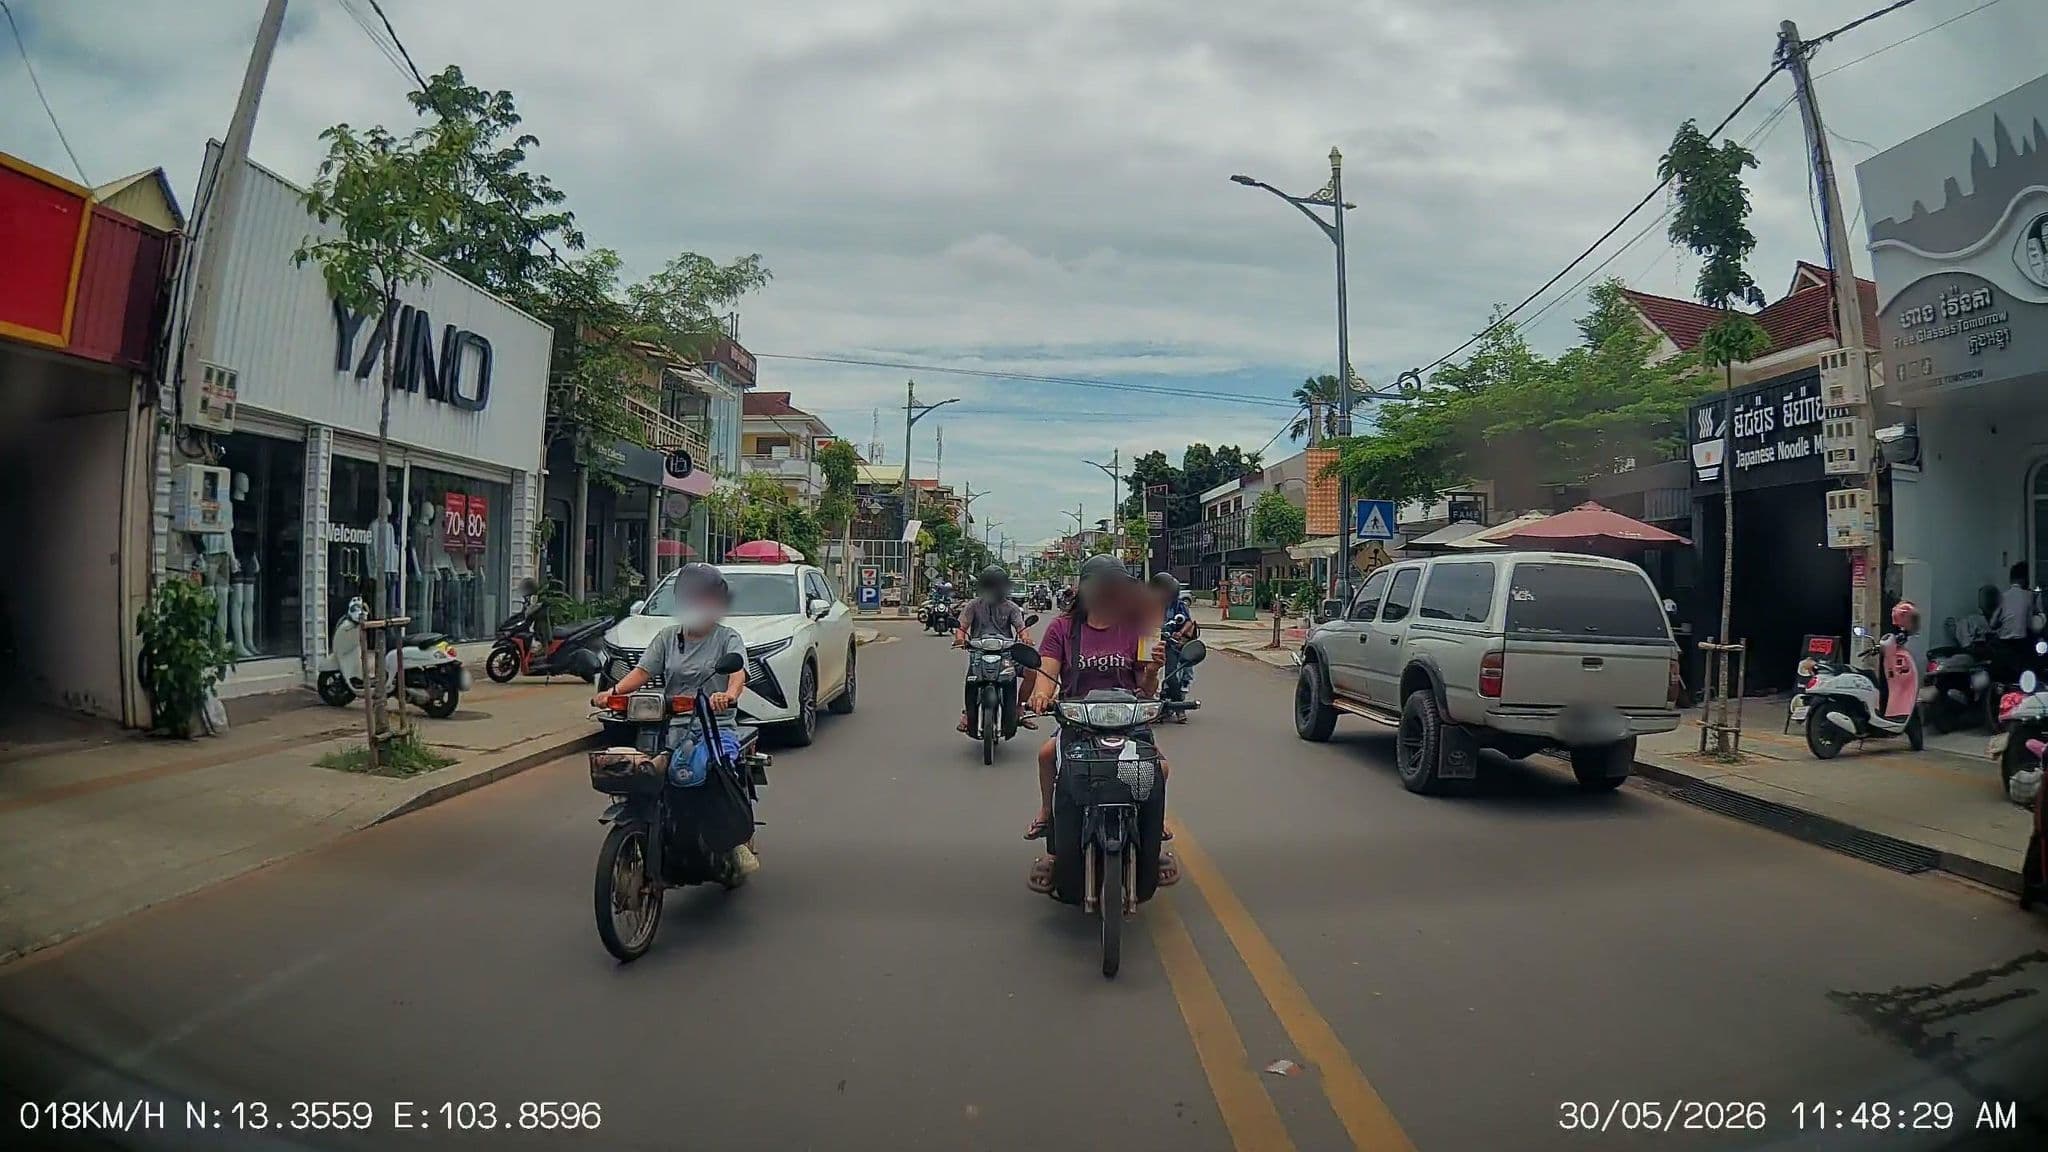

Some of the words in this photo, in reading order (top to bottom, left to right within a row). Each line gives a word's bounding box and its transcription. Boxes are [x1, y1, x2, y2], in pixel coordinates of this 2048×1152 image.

[1893, 336, 1915, 349] Free
[1916, 323, 1957, 343] Glasses
[1957, 310, 2009, 332] Tomorrow
[1735, 446, 1775, 471] Japanese
[1777, 435, 1810, 461] Noodle
[328, 522, 373, 544] Welcome
[862, 587, 877, 602] P
